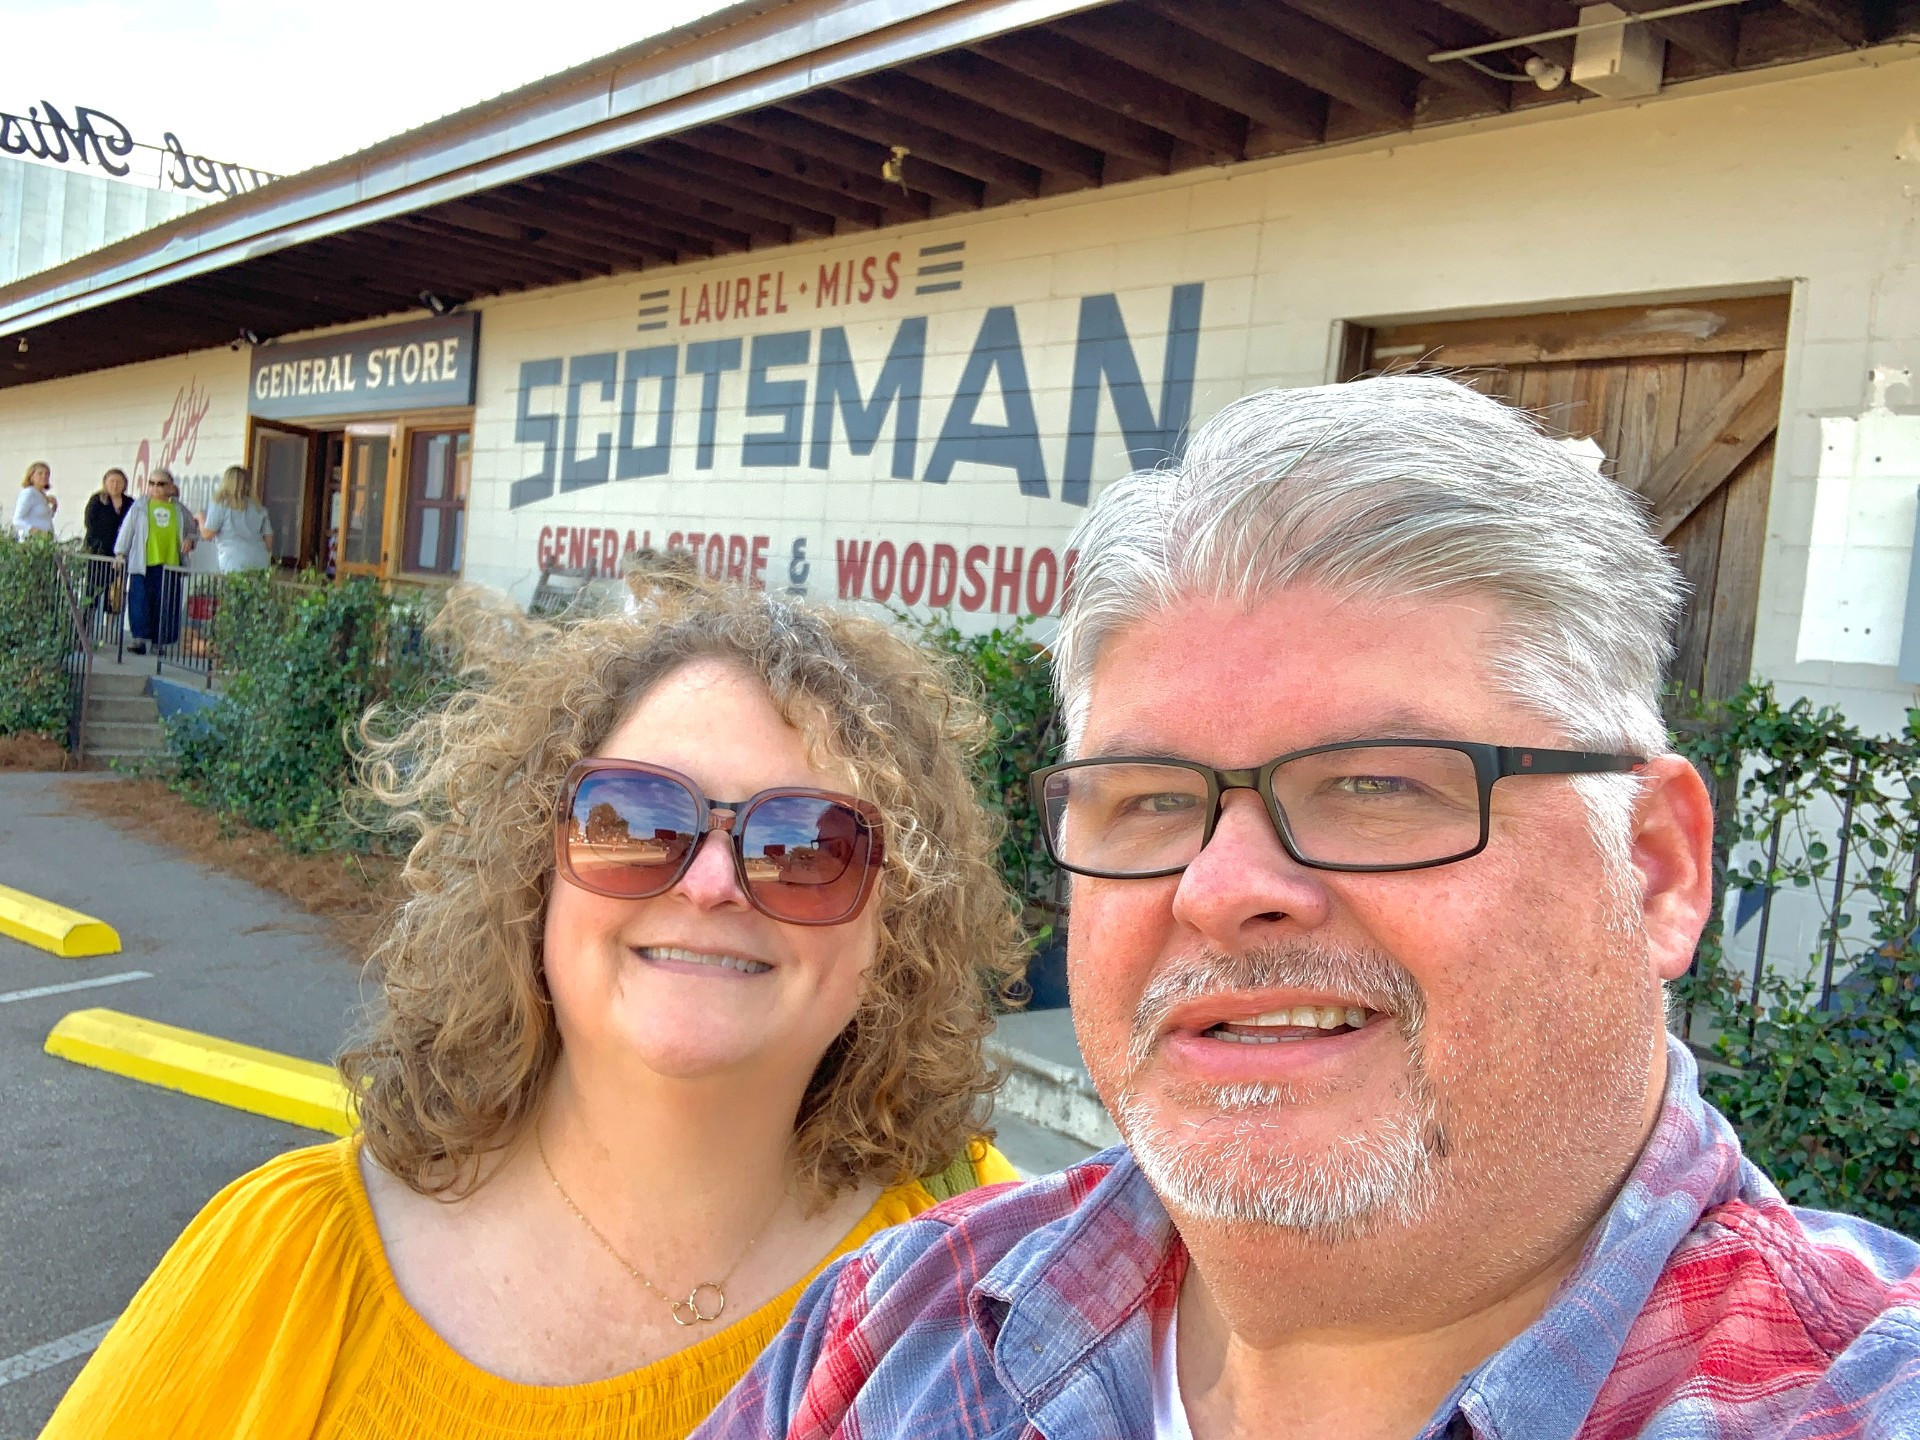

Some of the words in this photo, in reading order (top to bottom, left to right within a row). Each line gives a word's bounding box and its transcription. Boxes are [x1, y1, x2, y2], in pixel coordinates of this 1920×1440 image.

[679, 271, 788, 326] LAUREL
[815, 251, 901, 308] MISS
[255, 353, 357, 400] GENERAL
[366, 337, 459, 389] STORE
[510, 281, 1204, 511] SCOTSMAN
[787, 537, 811, 595] &
